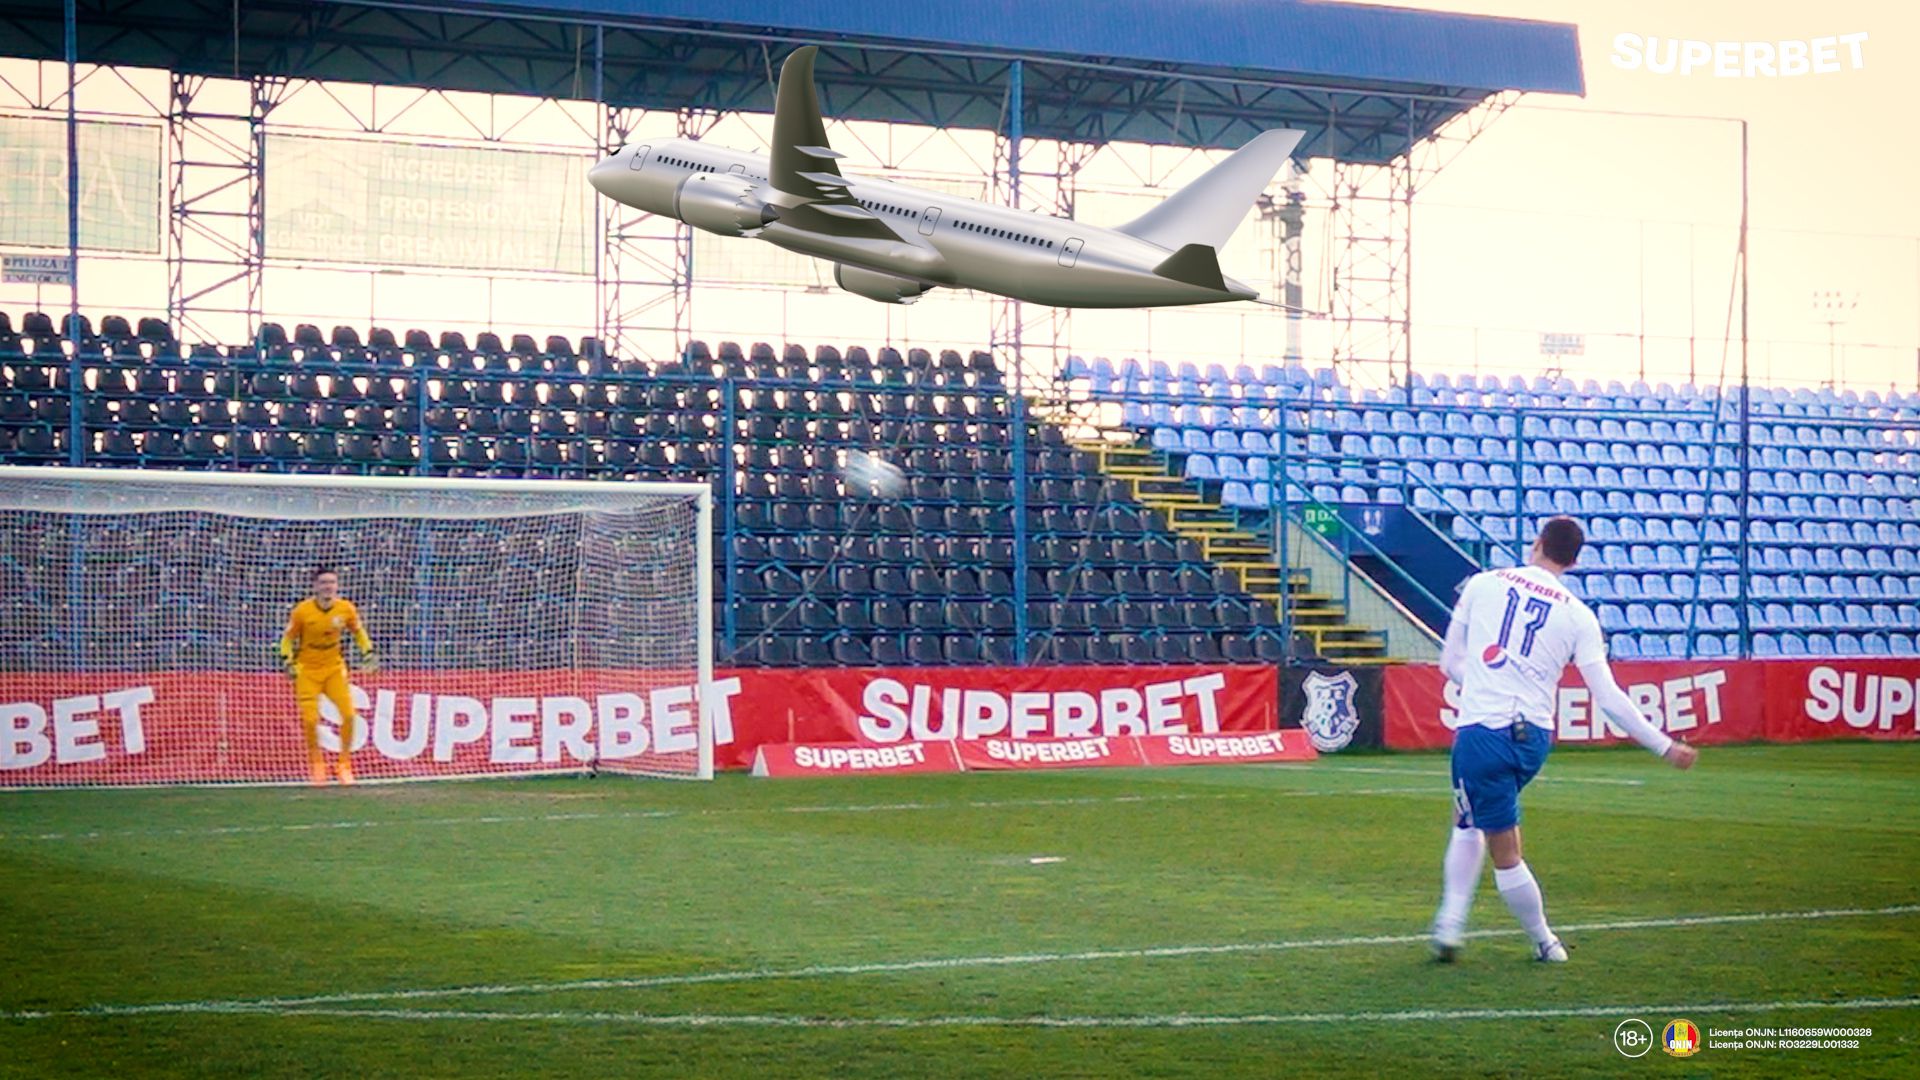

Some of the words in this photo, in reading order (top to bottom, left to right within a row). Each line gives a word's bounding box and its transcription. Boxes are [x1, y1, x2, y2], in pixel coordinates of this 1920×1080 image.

[1496, 570, 1570, 603] SUPERBET
[1498, 586, 1552, 658] 17
[858, 673, 1225, 742] SUPERBET
[1804, 666, 1920, 731] SUP
[794, 741, 926, 770] SUPERBET
[986, 736, 1111, 763] SUPERBET
[1168, 731, 1285, 758] SUPERBET
